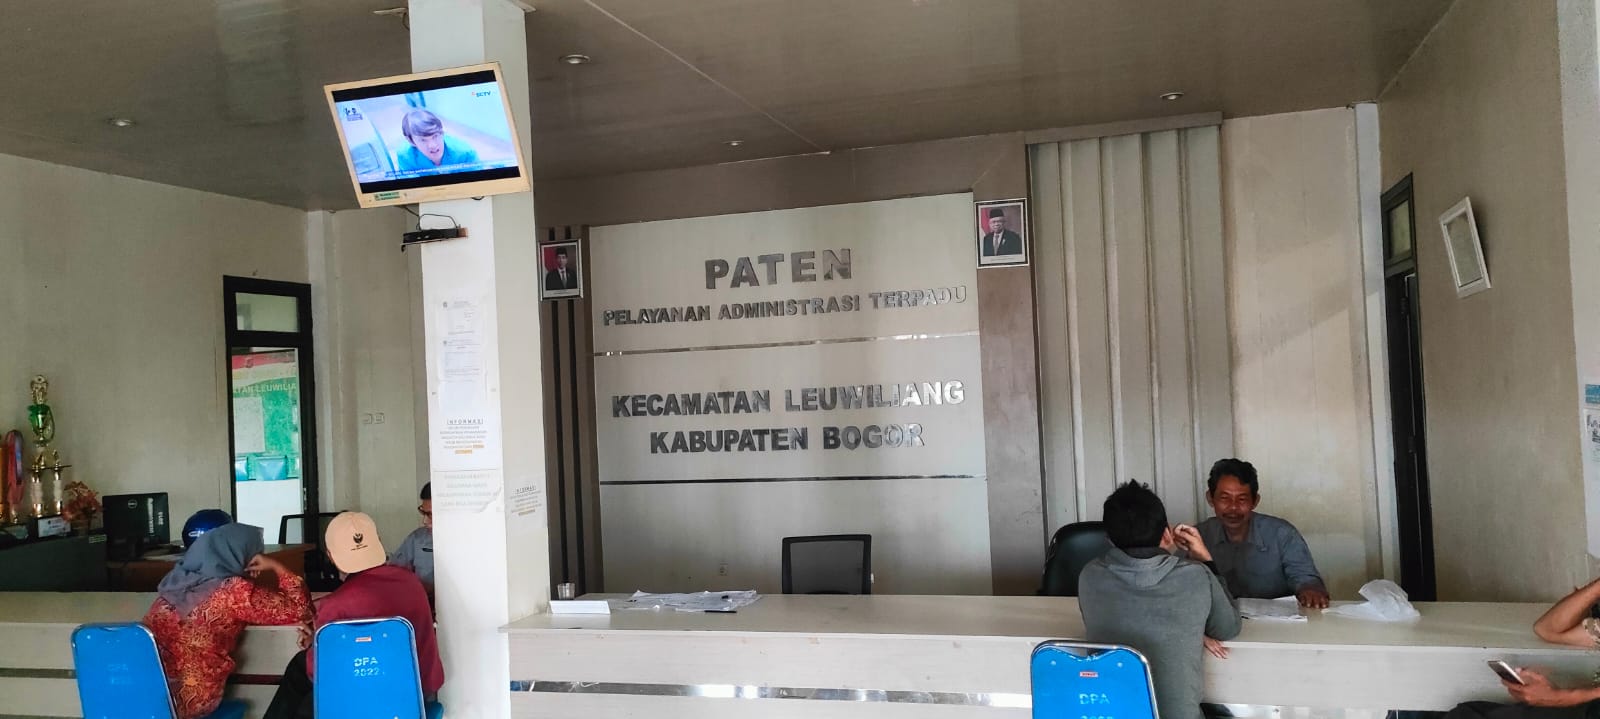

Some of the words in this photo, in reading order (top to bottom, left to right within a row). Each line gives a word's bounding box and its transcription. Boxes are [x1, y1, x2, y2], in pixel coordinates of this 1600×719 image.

[704, 248, 853, 290] PATEN
[603, 304, 711, 326] PELAYANAN
[718, 294, 861, 320] ADMINISTRASI
[869, 285, 968, 309] TERPADU
[611, 389, 771, 418] KECAMATAN
[784, 380, 965, 412] LEUWILIANG
[650, 426, 808, 454] KABUPATEN
[823, 423, 925, 451] BOGOR
[354, 656, 378, 667] DPA
[1079, 693, 1110, 705] DPA
